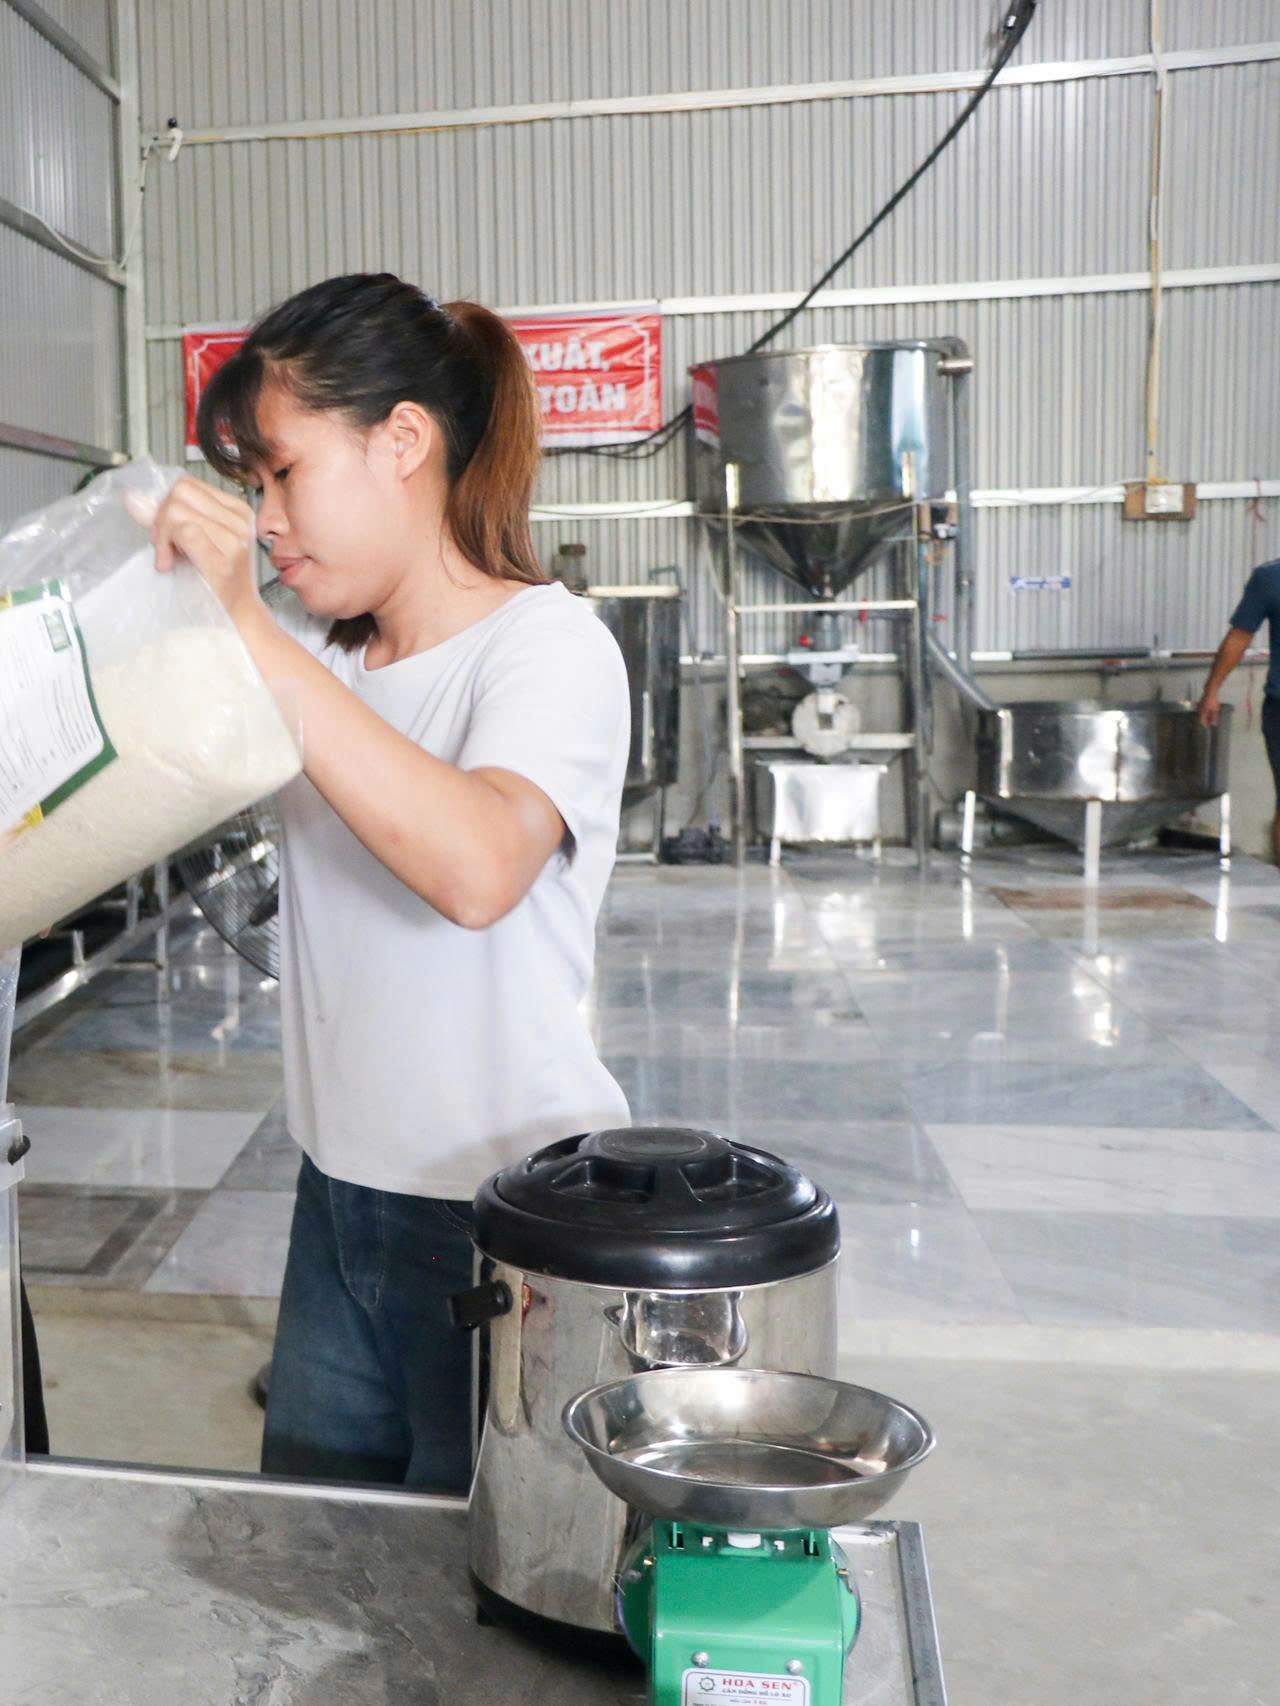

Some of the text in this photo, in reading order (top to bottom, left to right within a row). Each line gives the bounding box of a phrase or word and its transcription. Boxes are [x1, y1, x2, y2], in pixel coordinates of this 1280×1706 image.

[537, 377, 626, 414] TOÀN
[722, 1678, 792, 1691] HOA SEN
